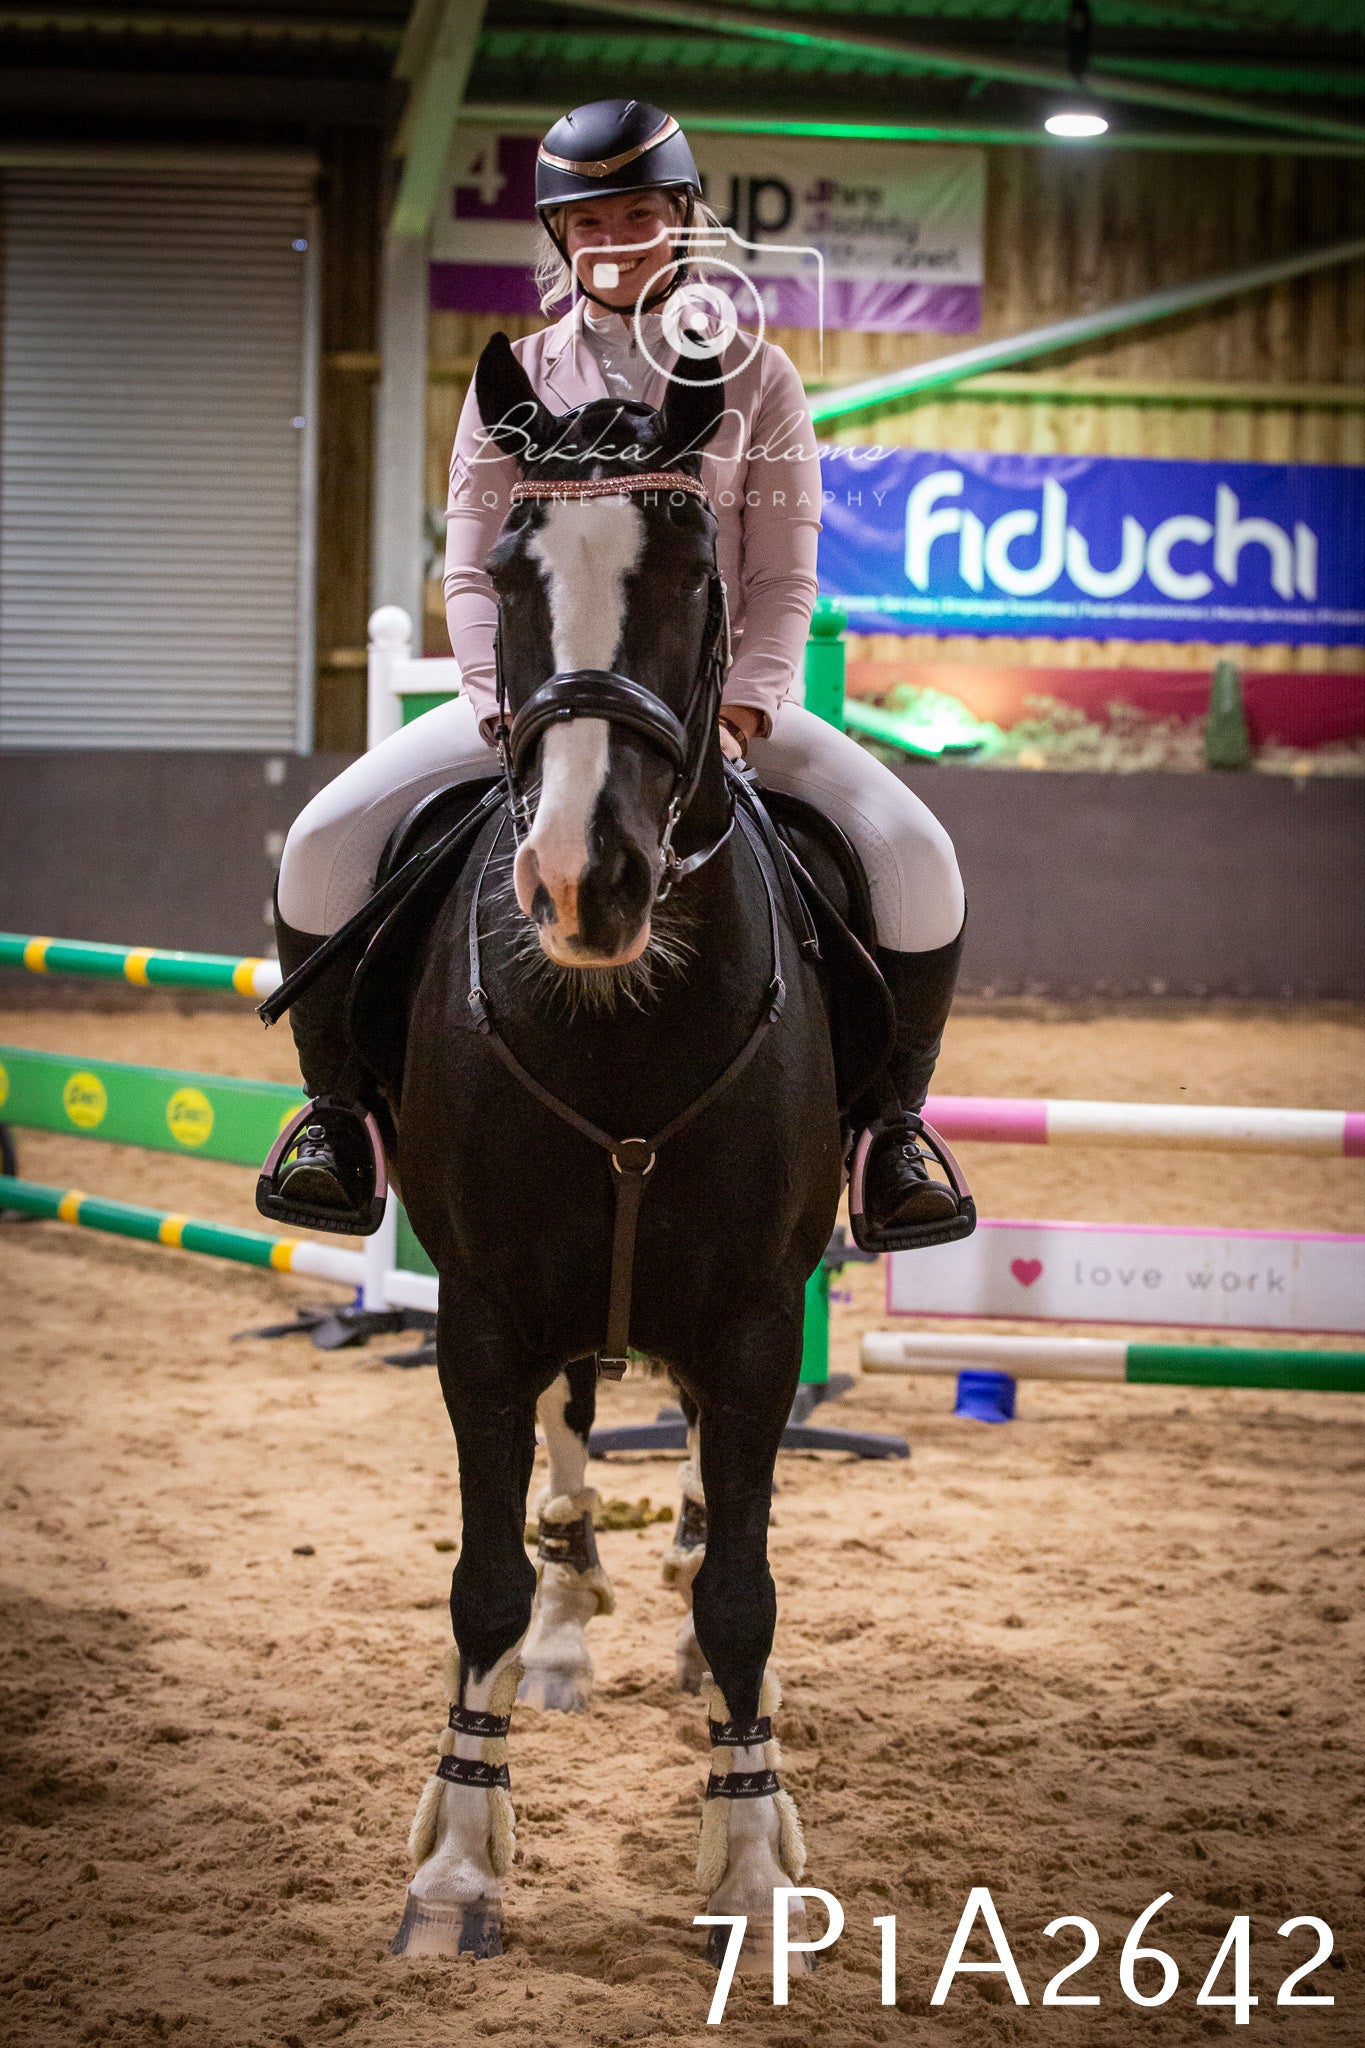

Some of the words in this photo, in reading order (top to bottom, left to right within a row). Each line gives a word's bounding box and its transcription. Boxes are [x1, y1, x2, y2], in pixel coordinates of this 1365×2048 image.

[904, 470, 1318, 601] fiduchi
[1075, 1261, 1163, 1287] love
[1187, 1267, 1285, 1294] work
